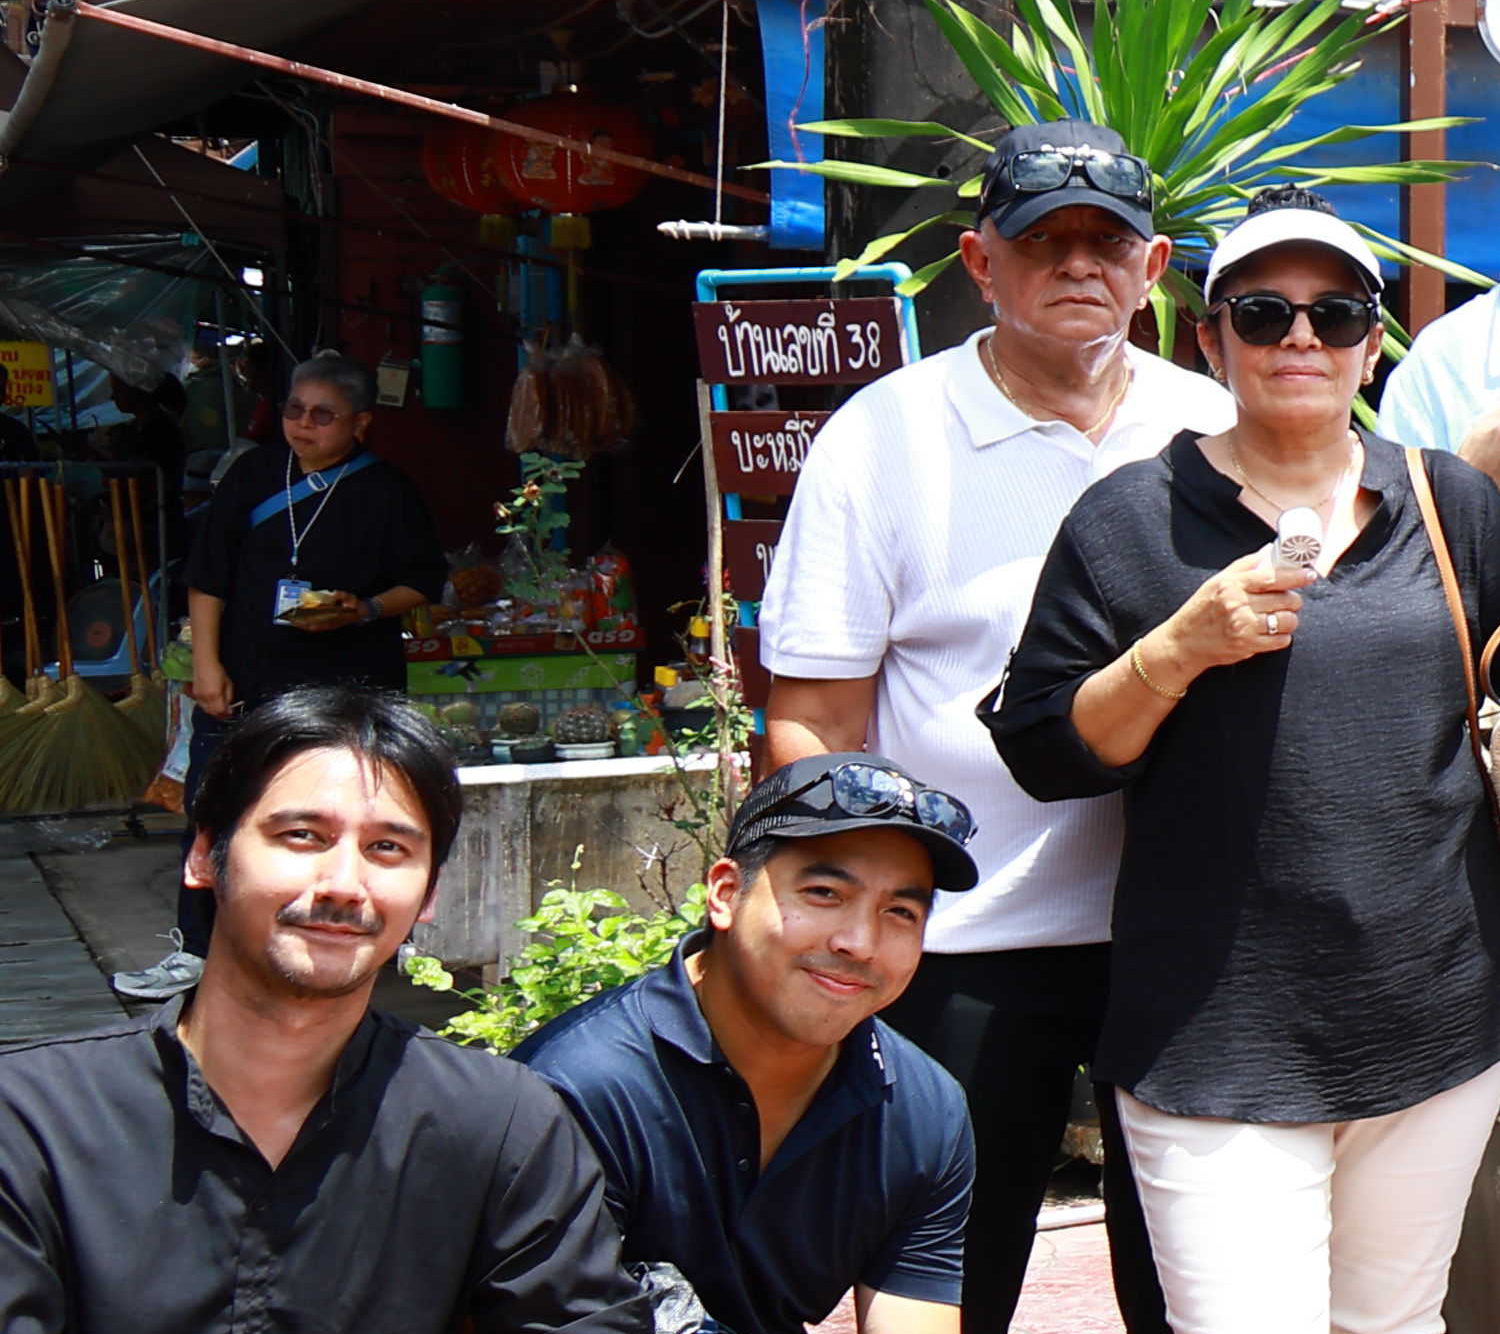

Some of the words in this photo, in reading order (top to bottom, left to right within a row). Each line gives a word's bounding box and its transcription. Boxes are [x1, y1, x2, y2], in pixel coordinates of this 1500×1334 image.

[717, 300, 841, 378] บ้านเลขที่
[845, 320, 881, 370] 38
[404, 638, 440, 654] GS
[587, 628, 636, 645] GSD
